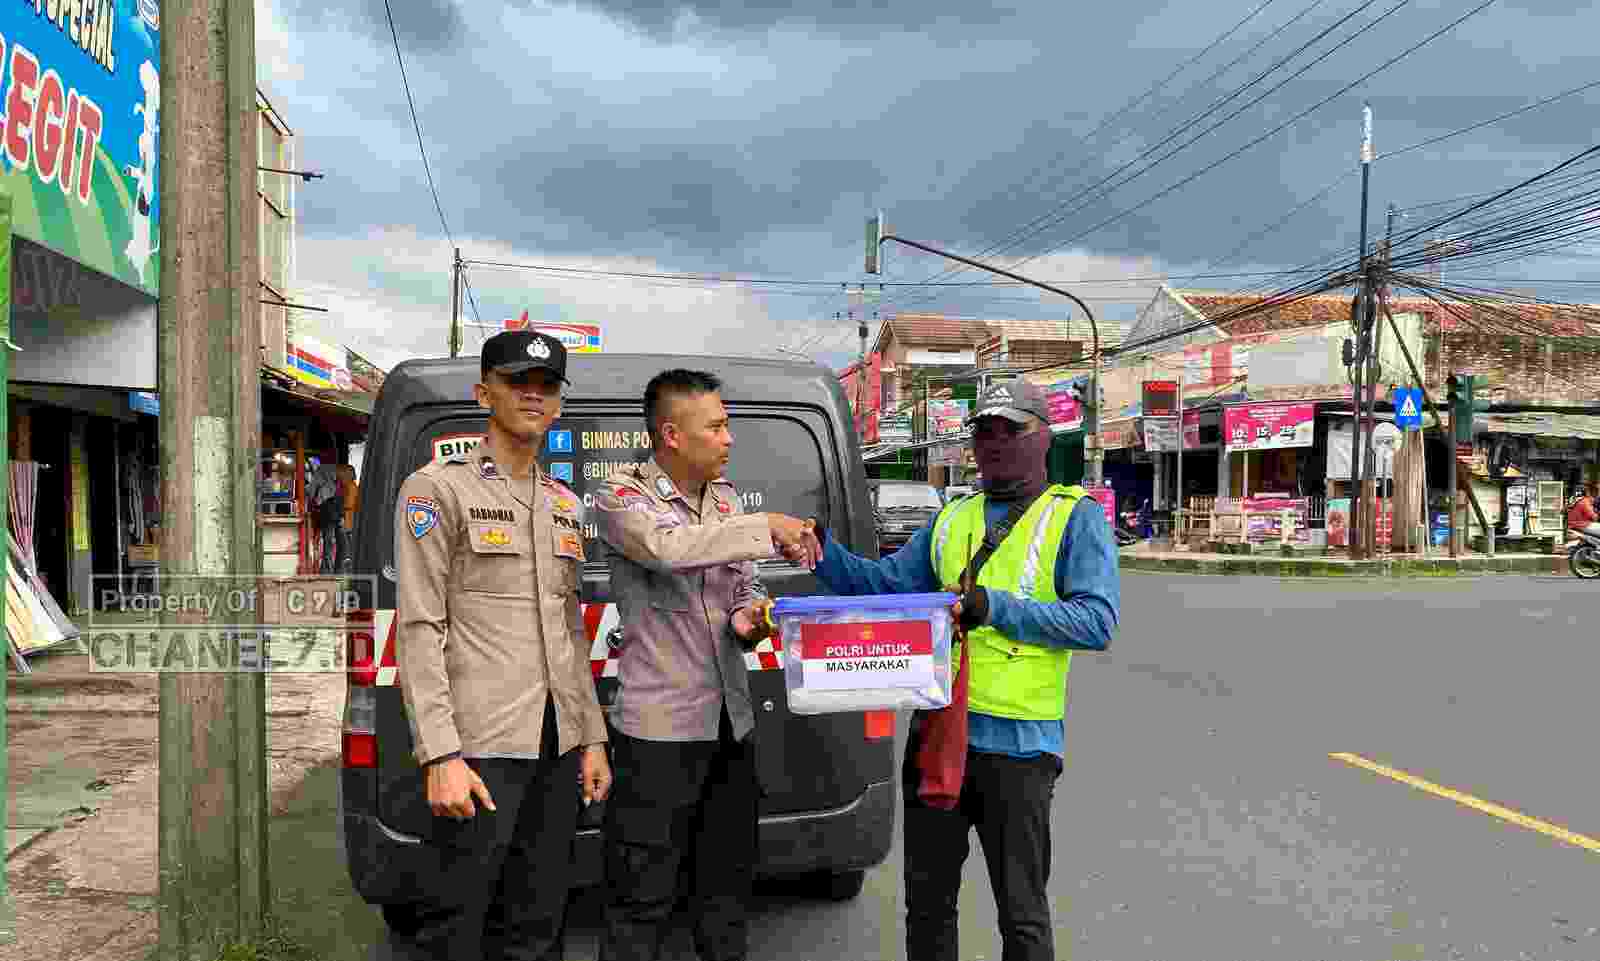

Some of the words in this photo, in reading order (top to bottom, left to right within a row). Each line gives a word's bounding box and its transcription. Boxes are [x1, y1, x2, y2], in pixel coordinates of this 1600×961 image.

[0, 31, 103, 206] EGIT
[582, 432, 632, 448] BINMAS
[633, 432, 655, 448] PO
[826, 645, 865, 658] POLRI
[867, 643, 912, 656] UNTUK
[826, 658, 911, 672] MASYARAKAT
